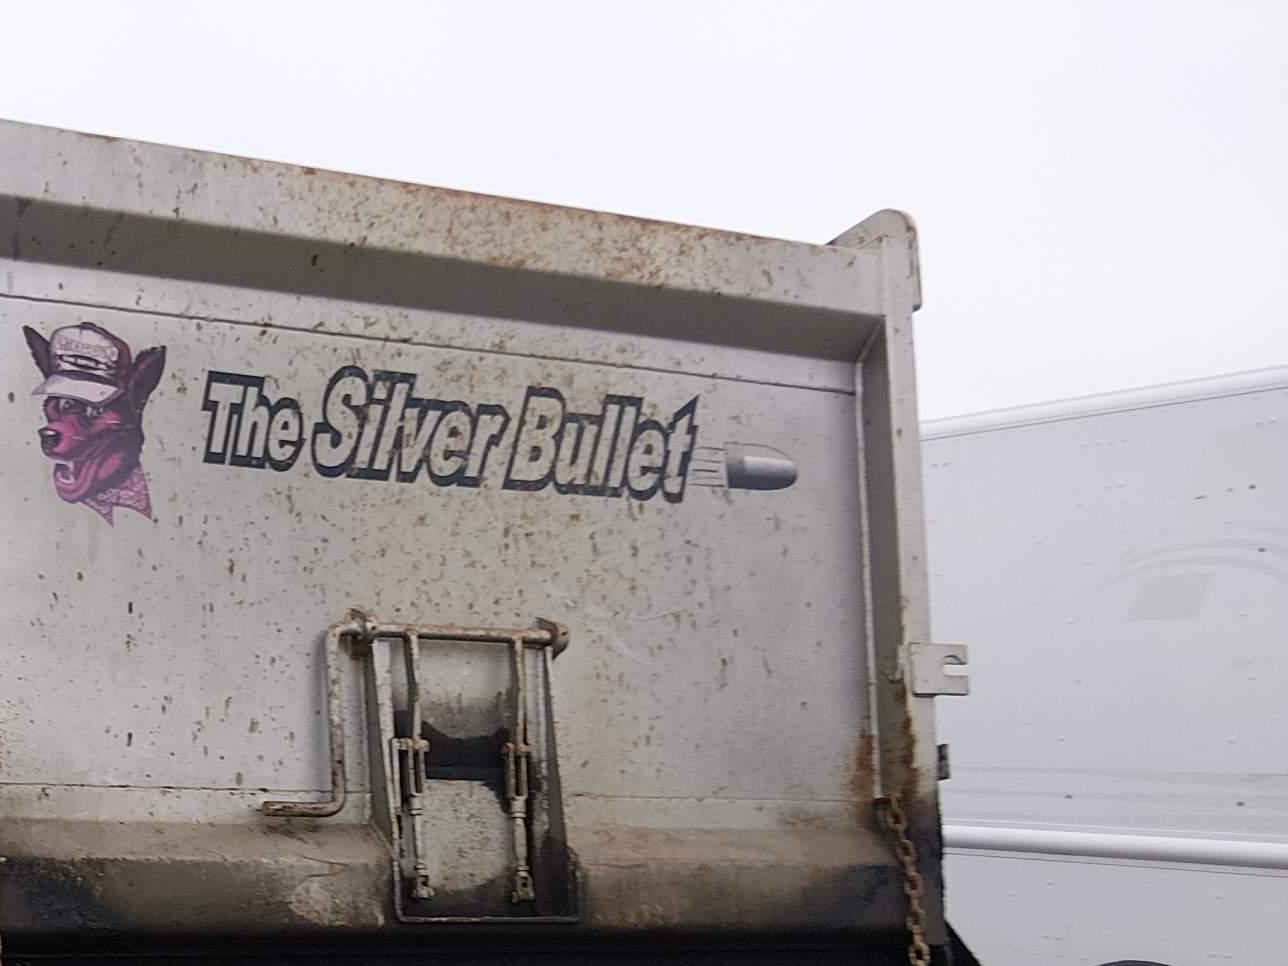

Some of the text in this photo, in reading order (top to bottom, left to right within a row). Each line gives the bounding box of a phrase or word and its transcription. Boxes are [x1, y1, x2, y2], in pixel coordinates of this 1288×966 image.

[202, 365, 701, 504] The Silver Bullet
